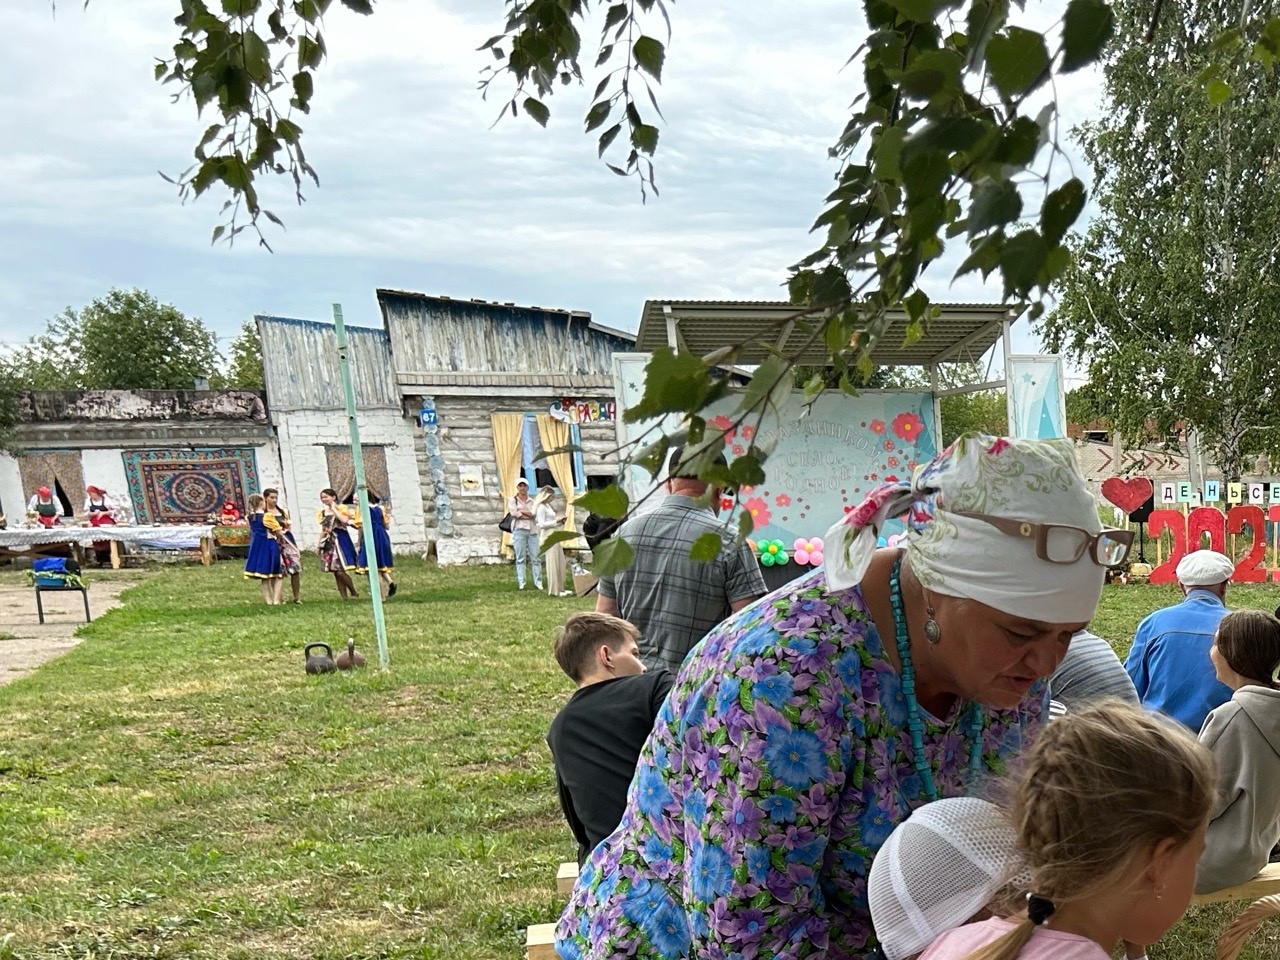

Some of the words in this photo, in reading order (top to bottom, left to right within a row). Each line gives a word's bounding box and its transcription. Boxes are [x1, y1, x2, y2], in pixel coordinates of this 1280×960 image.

[422, 412, 436, 422] 87
[787, 451, 837, 467] СЕЛО
[1164, 482, 1240, 500] ДЕНЬ
